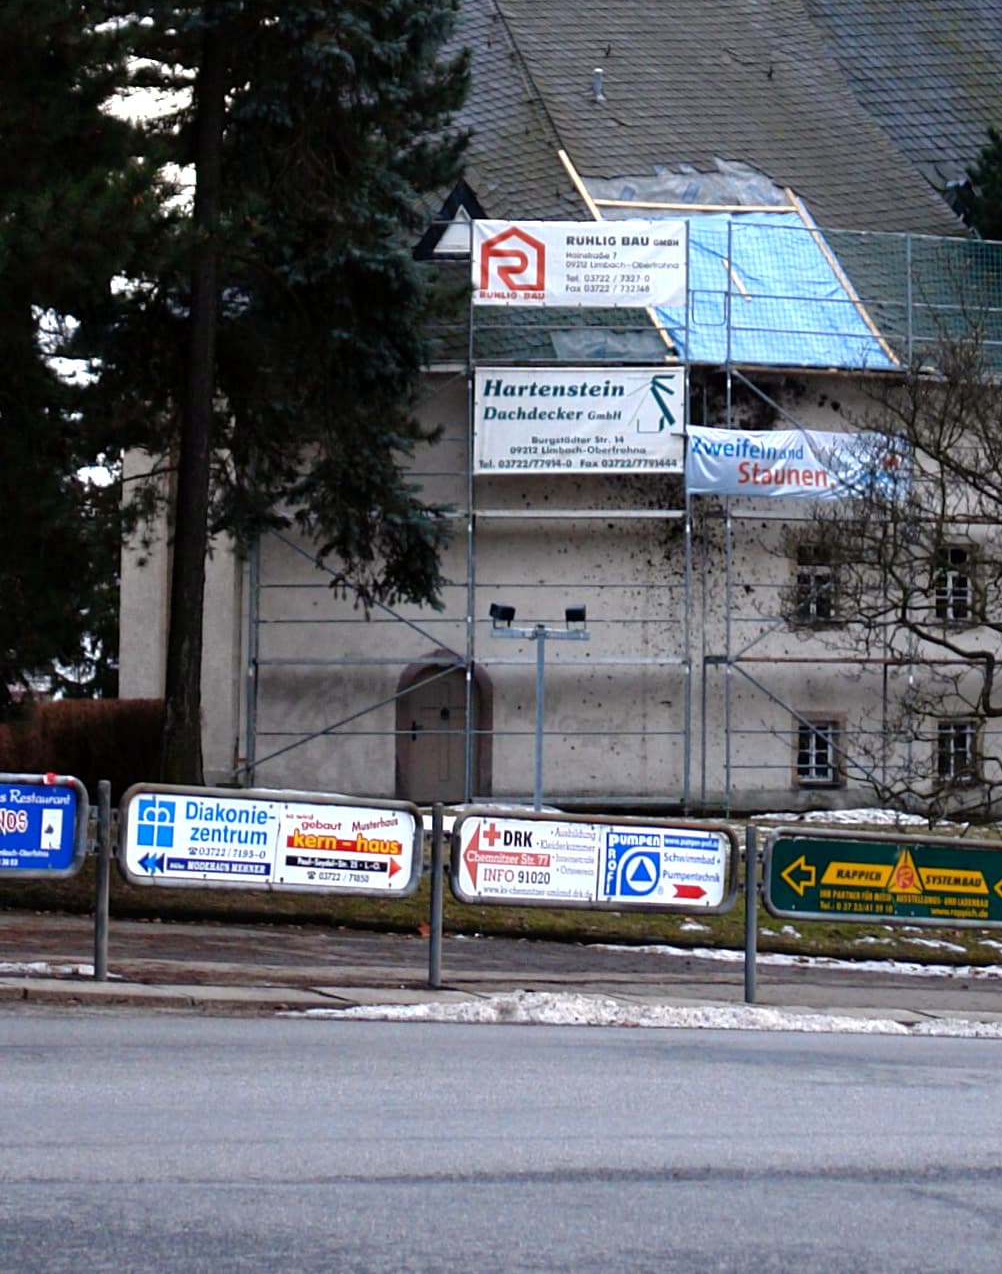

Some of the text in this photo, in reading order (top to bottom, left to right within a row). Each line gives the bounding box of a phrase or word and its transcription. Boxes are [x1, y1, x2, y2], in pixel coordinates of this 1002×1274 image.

[565, 235, 679, 247] RUHLIG BAU GMBH
[612, 251, 617, 259] 7
[584, 274, 609, 282] 03722
[480, 291, 545, 300] RUHLIG BAU
[565, 284, 581, 293] Fax
[483, 379, 625, 397] Hartenstein
[483, 406, 622, 421] Dachdecker GmbH
[594, 436, 611, 444] Str.
[510, 446, 647, 454] 09212 Limbach-Oberfrohna
[479, 459, 496, 468] Tel.
[580, 459, 598, 468] Fax
[737, 461, 837, 489] Staunen.
[9, 789, 71, 805] Restaurant
[185, 801, 276, 825] Diakonie-
[301, 820, 342, 831] gebaut
[352, 817, 399, 832] Musterhaus
[190, 825, 268, 846] zentrum
[293, 828, 337, 849] kern
[356, 833, 399, 854] haus
[503, 830, 533, 847] DRK
[466, 850, 518, 864] Chemnitzer
[520, 853, 534, 865] Str.
[537, 854, 549, 865] 77
[483, 868, 551, 885] INFO 91020
[924, 874, 982, 887] SYSTEMBAU
